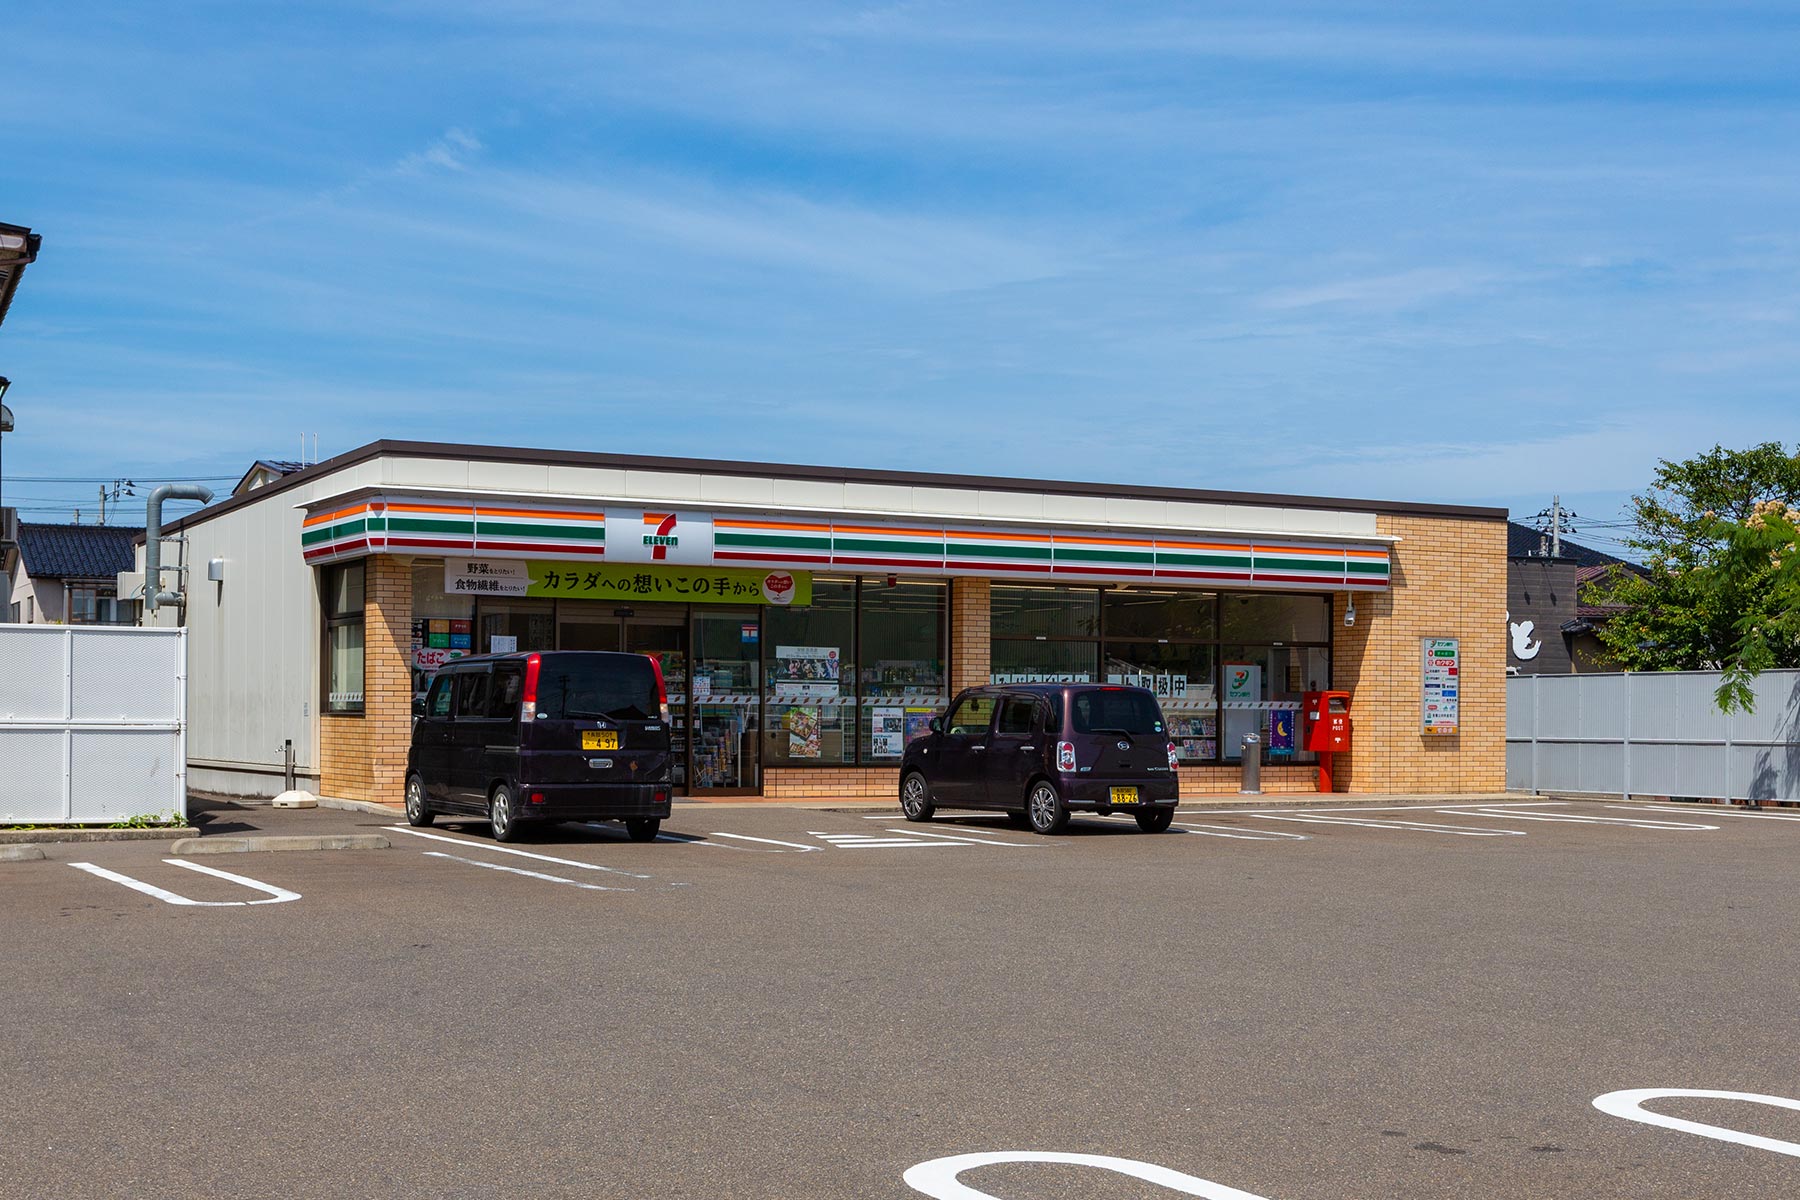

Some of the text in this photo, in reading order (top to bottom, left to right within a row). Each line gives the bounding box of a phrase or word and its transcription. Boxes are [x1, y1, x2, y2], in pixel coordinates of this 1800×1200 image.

[643, 512, 677, 560] 7
[543, 570, 760, 597] カラダへの想いこの手から
[417, 651, 444, 665] たばこ
